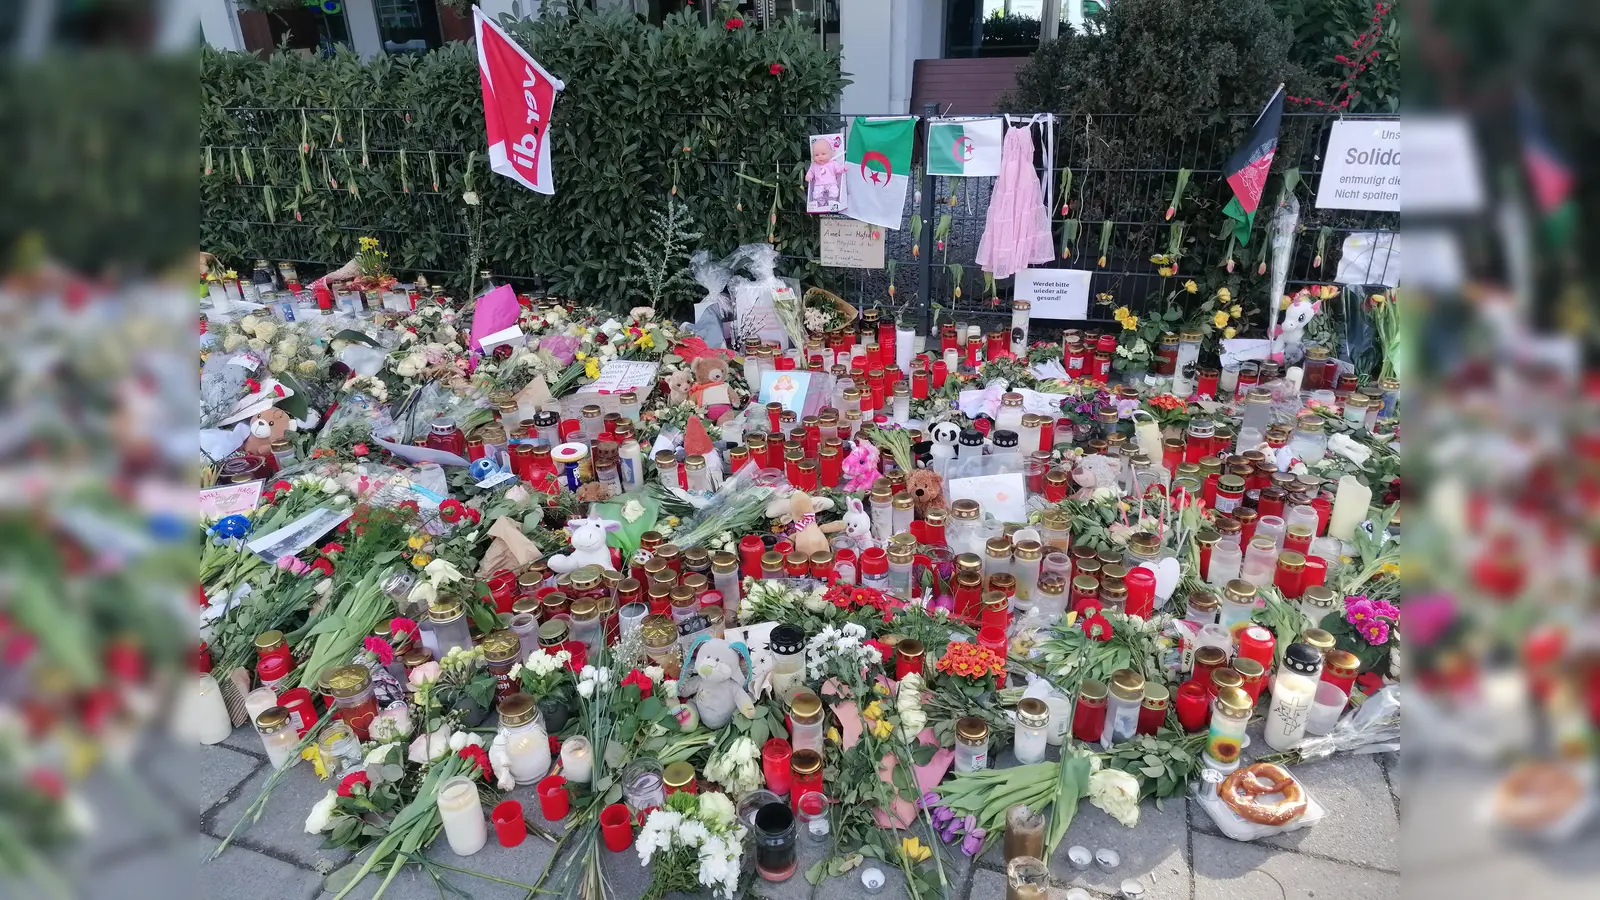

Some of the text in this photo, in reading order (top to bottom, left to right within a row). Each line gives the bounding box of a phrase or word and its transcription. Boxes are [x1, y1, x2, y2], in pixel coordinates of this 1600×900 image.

[1340, 175, 1385, 186] entmutigt
[1335, 190, 1398, 200] Nicht spalten
[824, 229, 840, 237] Amel
